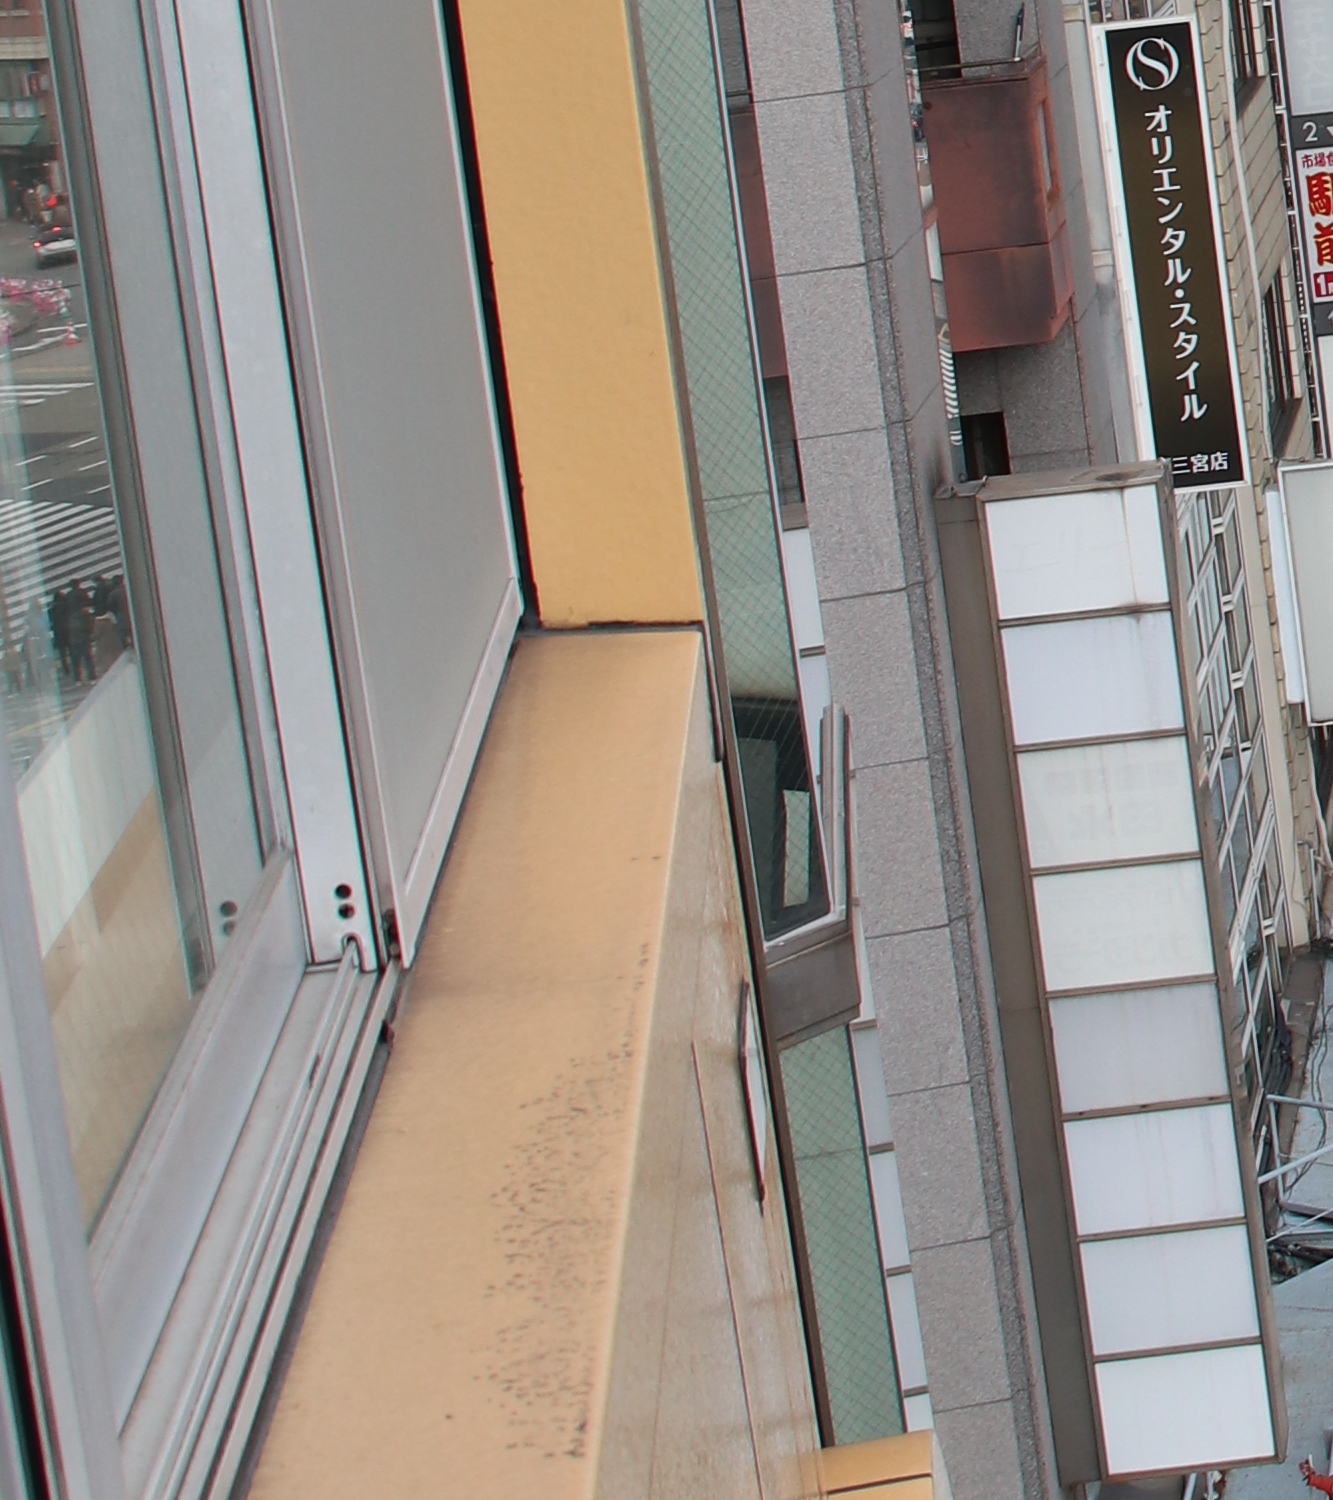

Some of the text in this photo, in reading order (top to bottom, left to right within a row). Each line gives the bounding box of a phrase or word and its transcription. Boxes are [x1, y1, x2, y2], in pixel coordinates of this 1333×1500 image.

[1301, 121, 1319, 143] 2
[1143, 104, 1208, 424] オリエンタル・スタイル
